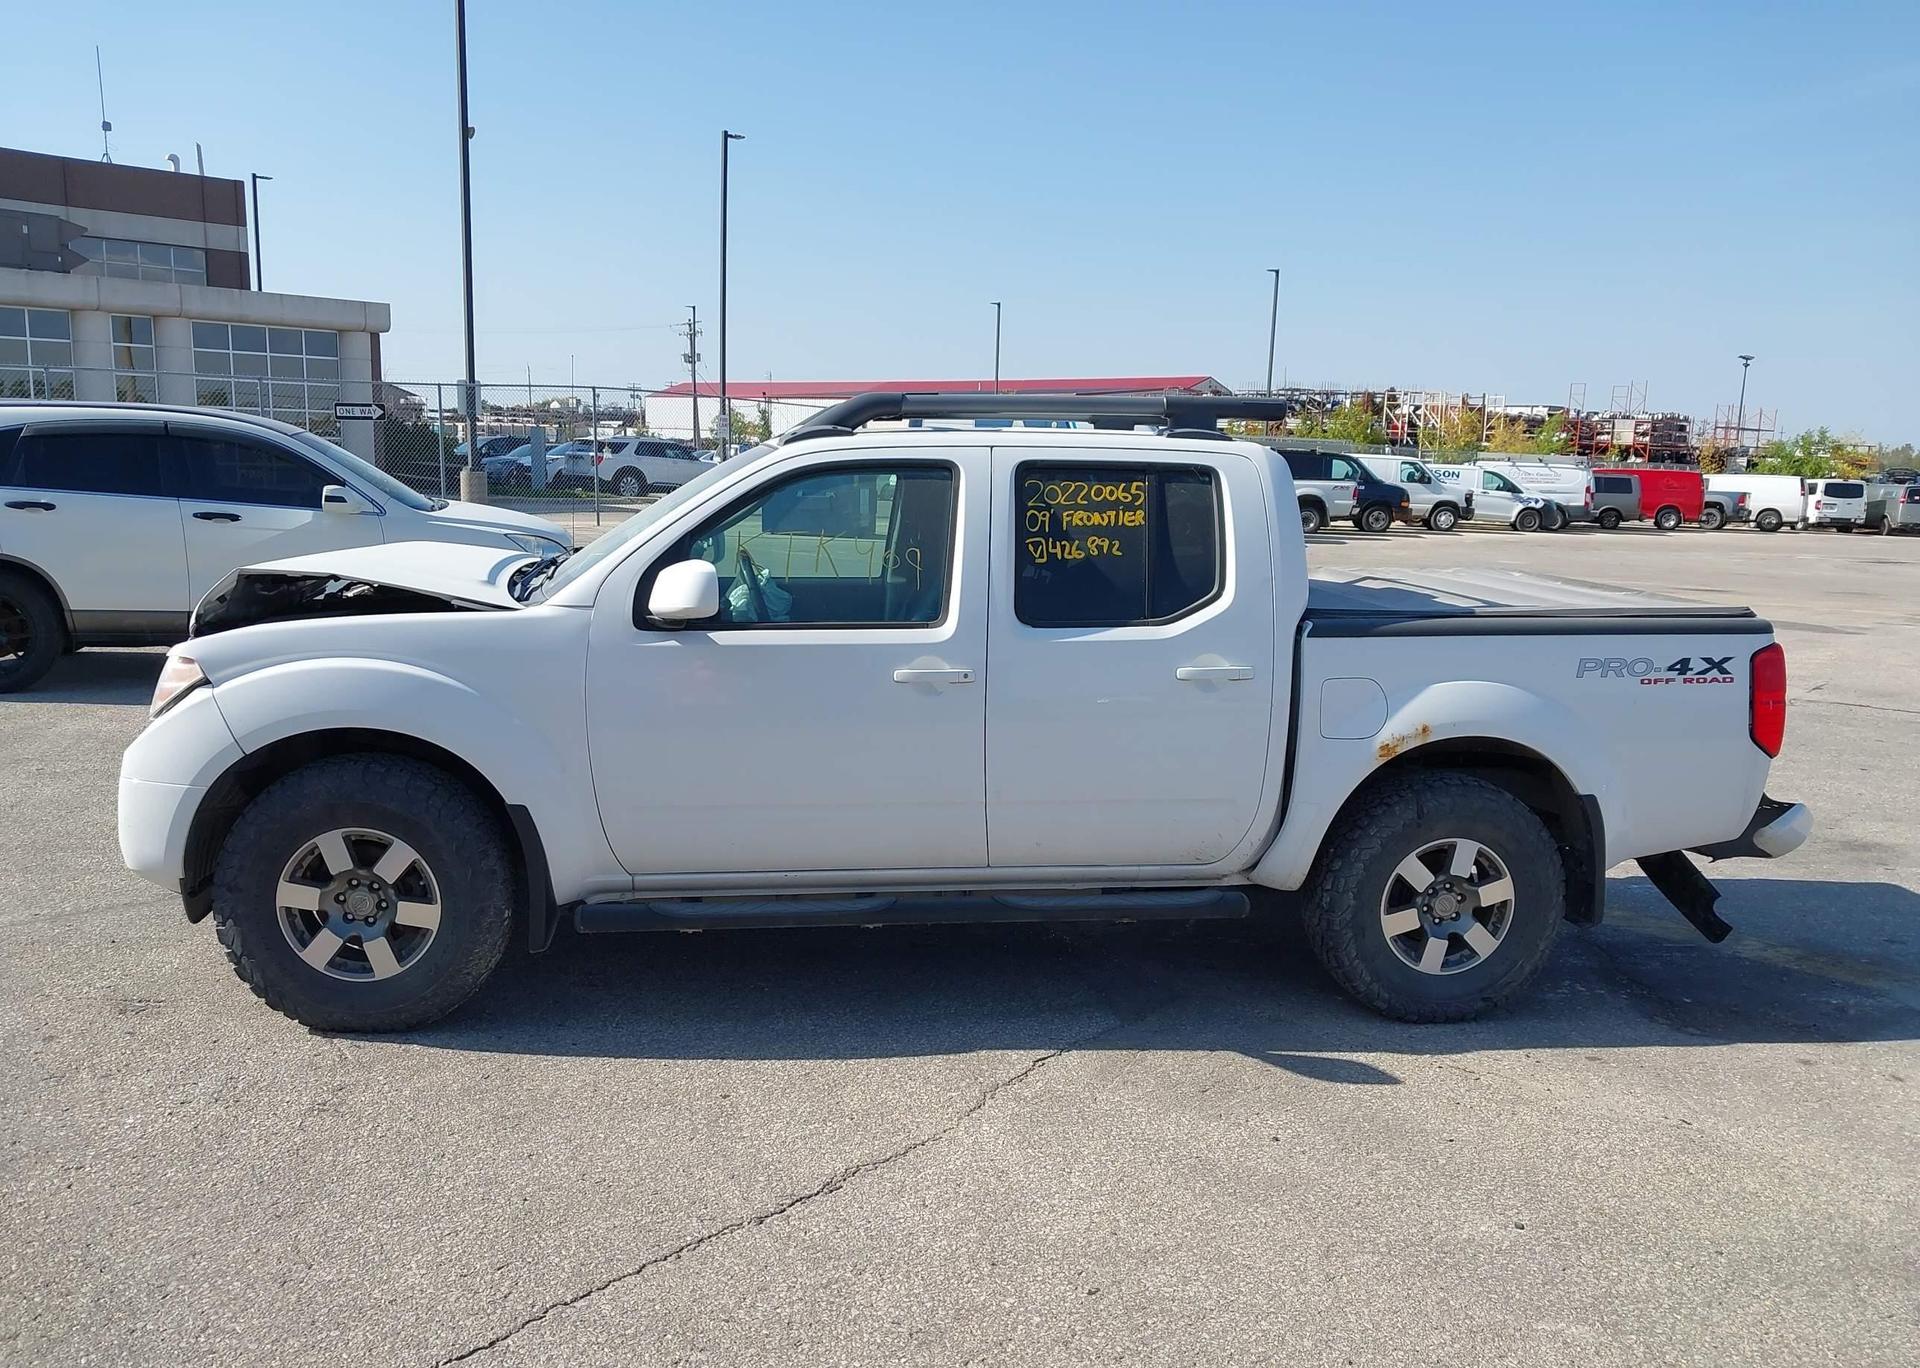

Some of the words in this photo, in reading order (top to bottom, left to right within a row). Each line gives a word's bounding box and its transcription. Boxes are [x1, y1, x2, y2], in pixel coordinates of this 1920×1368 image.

[338, 407, 356, 416] ONE
[359, 407, 378, 416] WAY
[1430, 469, 1461, 479] SON
[1024, 480, 1145, 506] 20220065
[1062, 506, 1146, 531] FRONTIER
[1575, 656, 1736, 679] PRO-4X
[1639, 677, 1677, 686] OFF
[1682, 676, 1735, 685] ROAD
